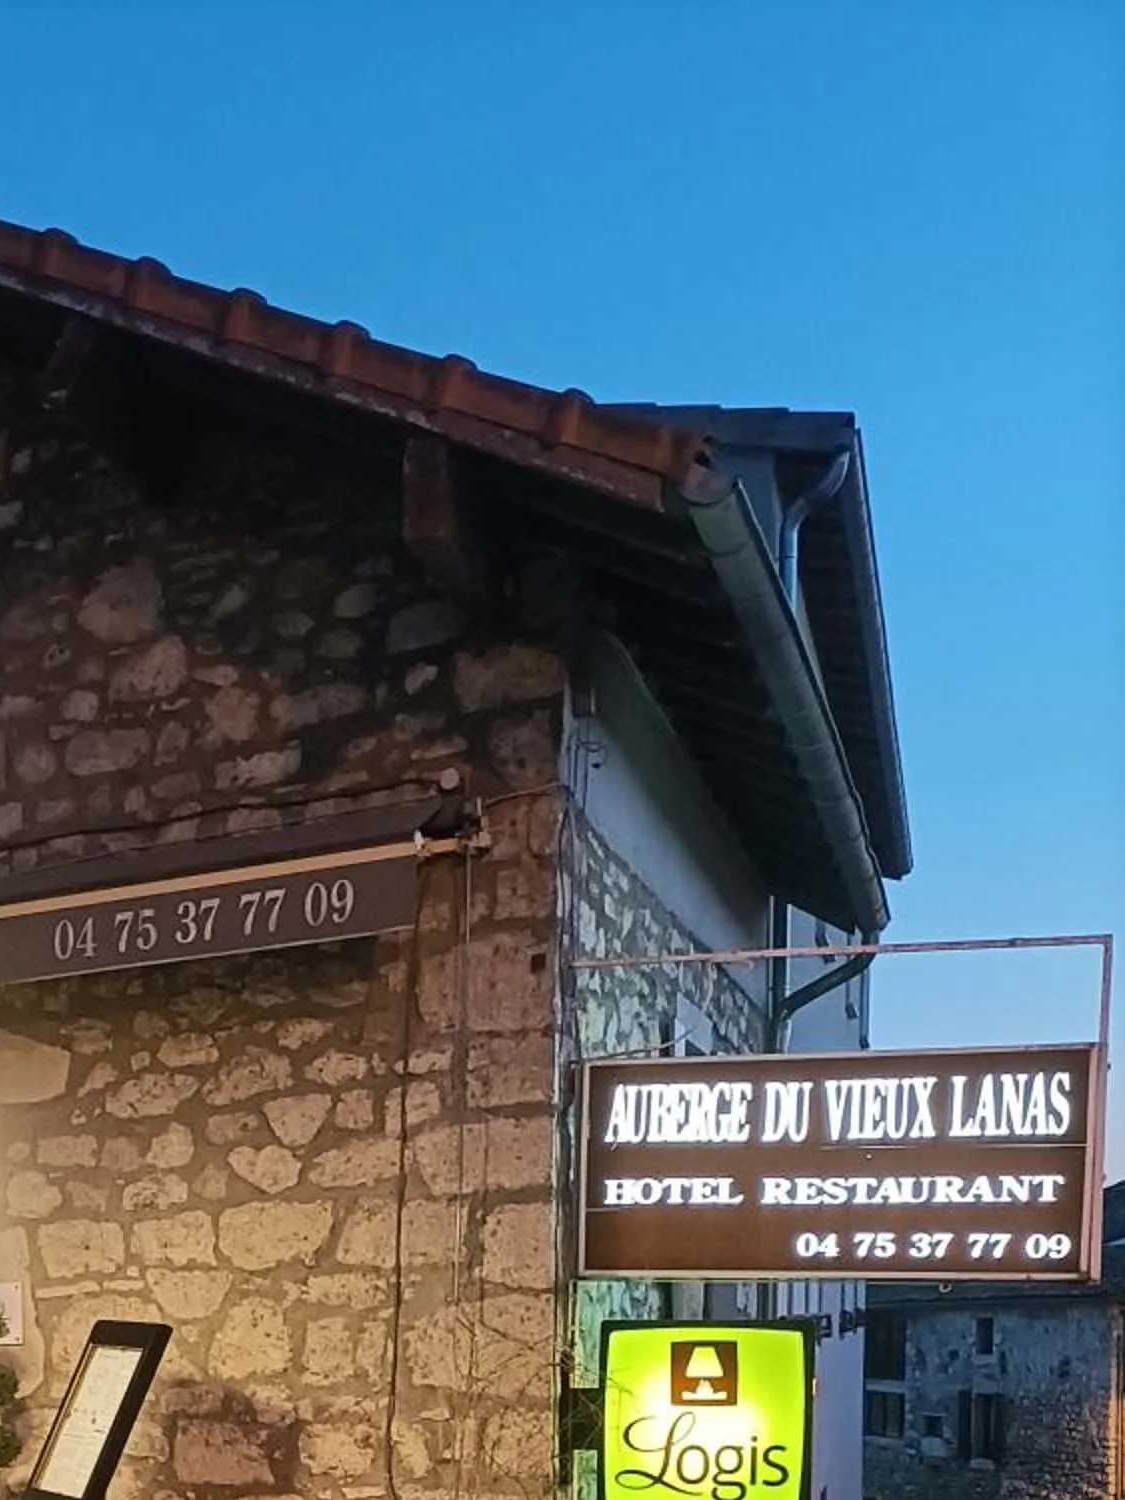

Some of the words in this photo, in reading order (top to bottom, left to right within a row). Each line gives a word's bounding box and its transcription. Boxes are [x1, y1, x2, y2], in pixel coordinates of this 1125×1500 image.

[53, 918, 98, 961] 04
[114, 907, 158, 954] 75
[175, 898, 220, 945] 37
[238, 888, 287, 936] 77
[304, 879, 355, 927] 09
[604, 1082, 752, 1143] AUBERGE
[762, 1080, 814, 1143] DU
[825, 1077, 939, 1141] VIEUX
[948, 1071, 1072, 1138] LANAS
[603, 1177, 744, 1206] HOTEL
[761, 1175, 1065, 1205] RESTAURANT
[795, 1233, 840, 1258] 04
[853, 1233, 896, 1258] 75
[909, 1233, 953, 1258] 37
[967, 1233, 1012, 1258] 77
[1024, 1233, 1072, 1259] 09
